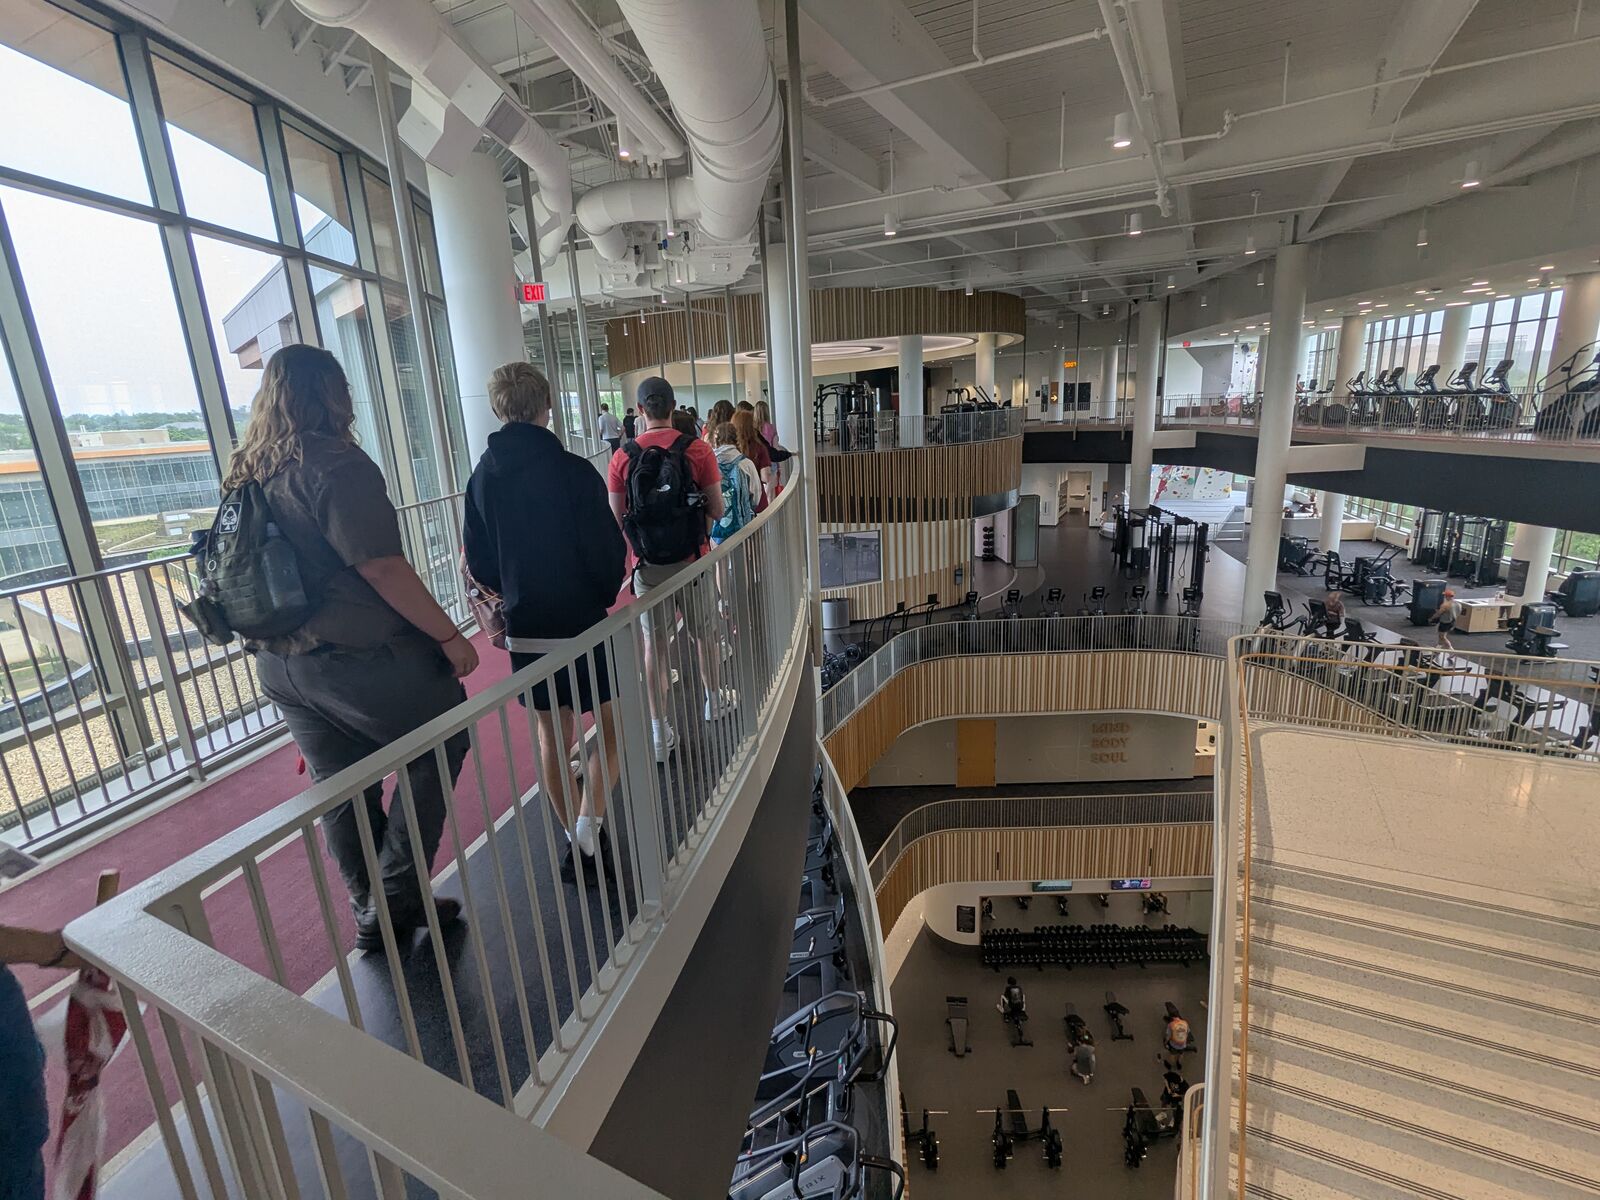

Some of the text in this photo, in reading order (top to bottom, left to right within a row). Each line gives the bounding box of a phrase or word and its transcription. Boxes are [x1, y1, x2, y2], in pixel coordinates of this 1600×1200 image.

[523, 284, 545, 301] EXIT
[1091, 722, 1131, 734] MIND
[1091, 736, 1129, 749] BODY
[1090, 751, 1129, 764] SOUL
